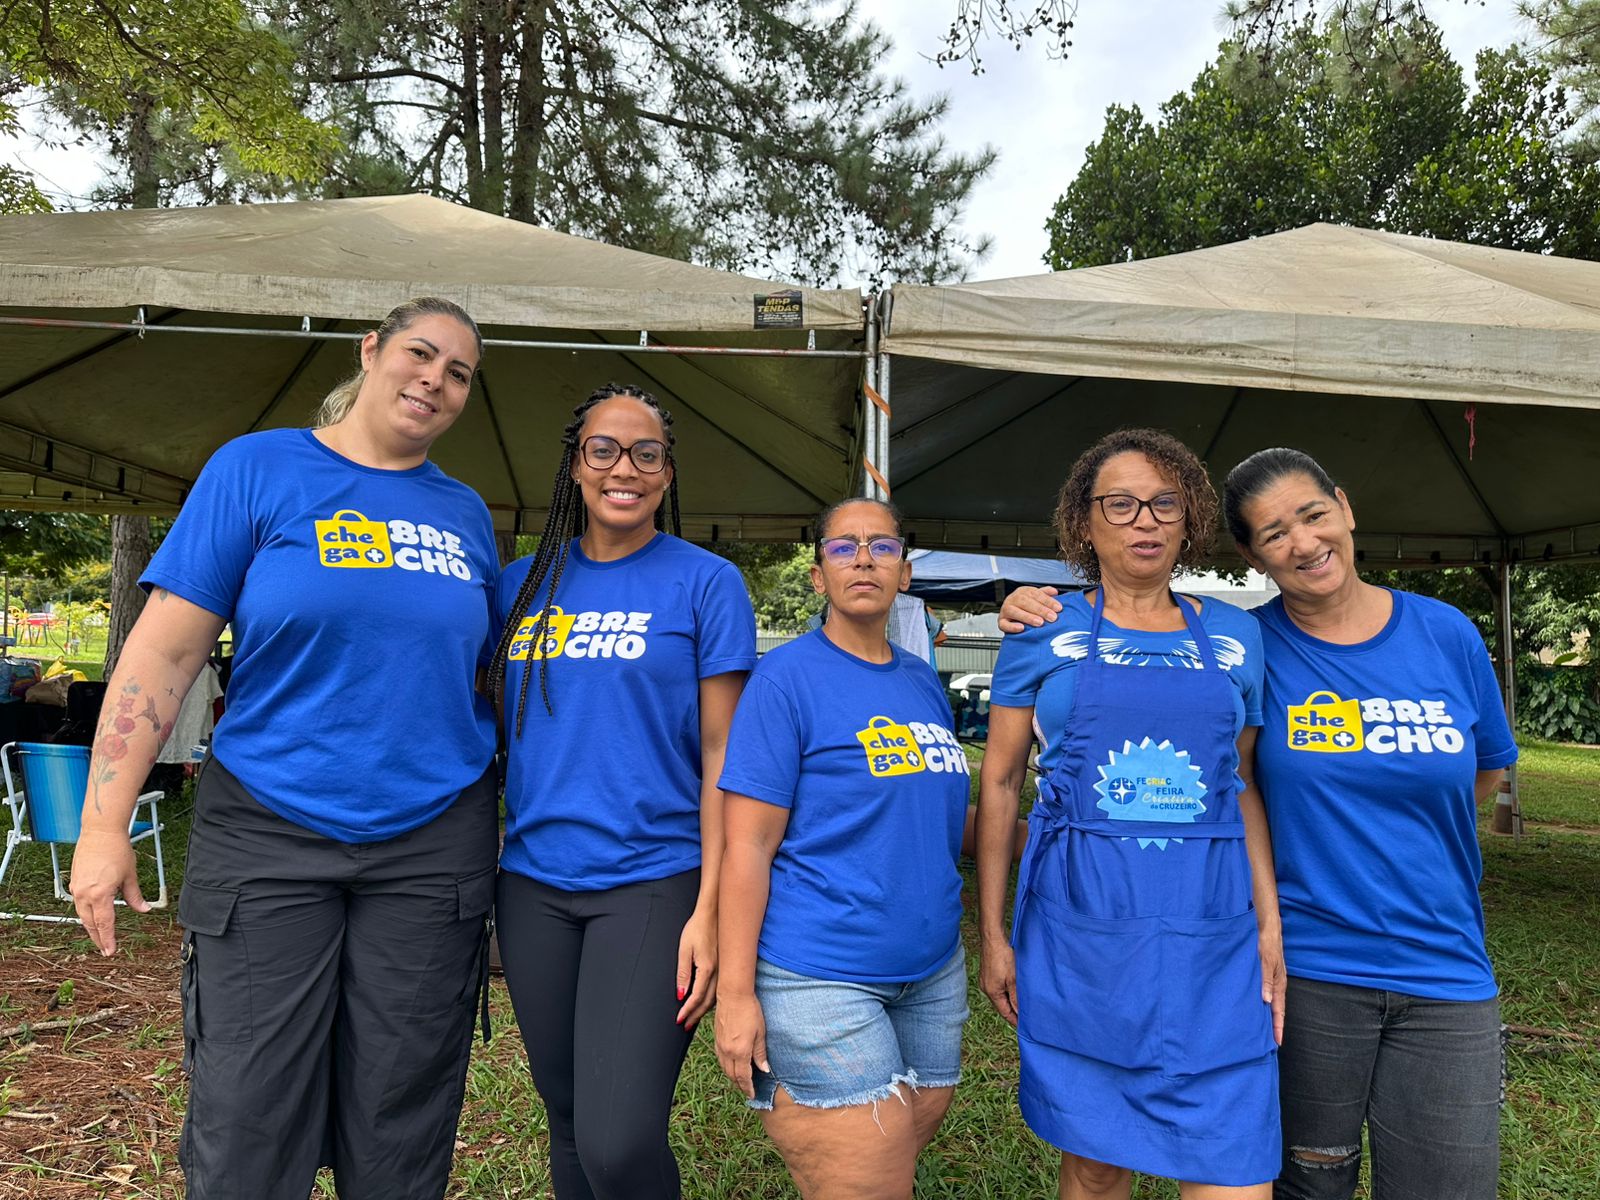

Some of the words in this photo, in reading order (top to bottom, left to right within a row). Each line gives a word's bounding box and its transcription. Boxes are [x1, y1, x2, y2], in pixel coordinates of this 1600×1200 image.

[757, 304, 800, 313] TENDAS
[323, 525, 374, 544] che
[387, 519, 465, 558] BRE
[394, 547, 472, 581] CHÓ
[572, 611, 652, 633] BRE
[564, 632, 647, 660] CHÓ
[1293, 710, 1345, 727] che
[1360, 697, 1453, 725] BRE
[869, 732, 908, 749] che
[1365, 725, 1465, 754] CHÓ
[1156, 787, 1184, 795] FEIRA
